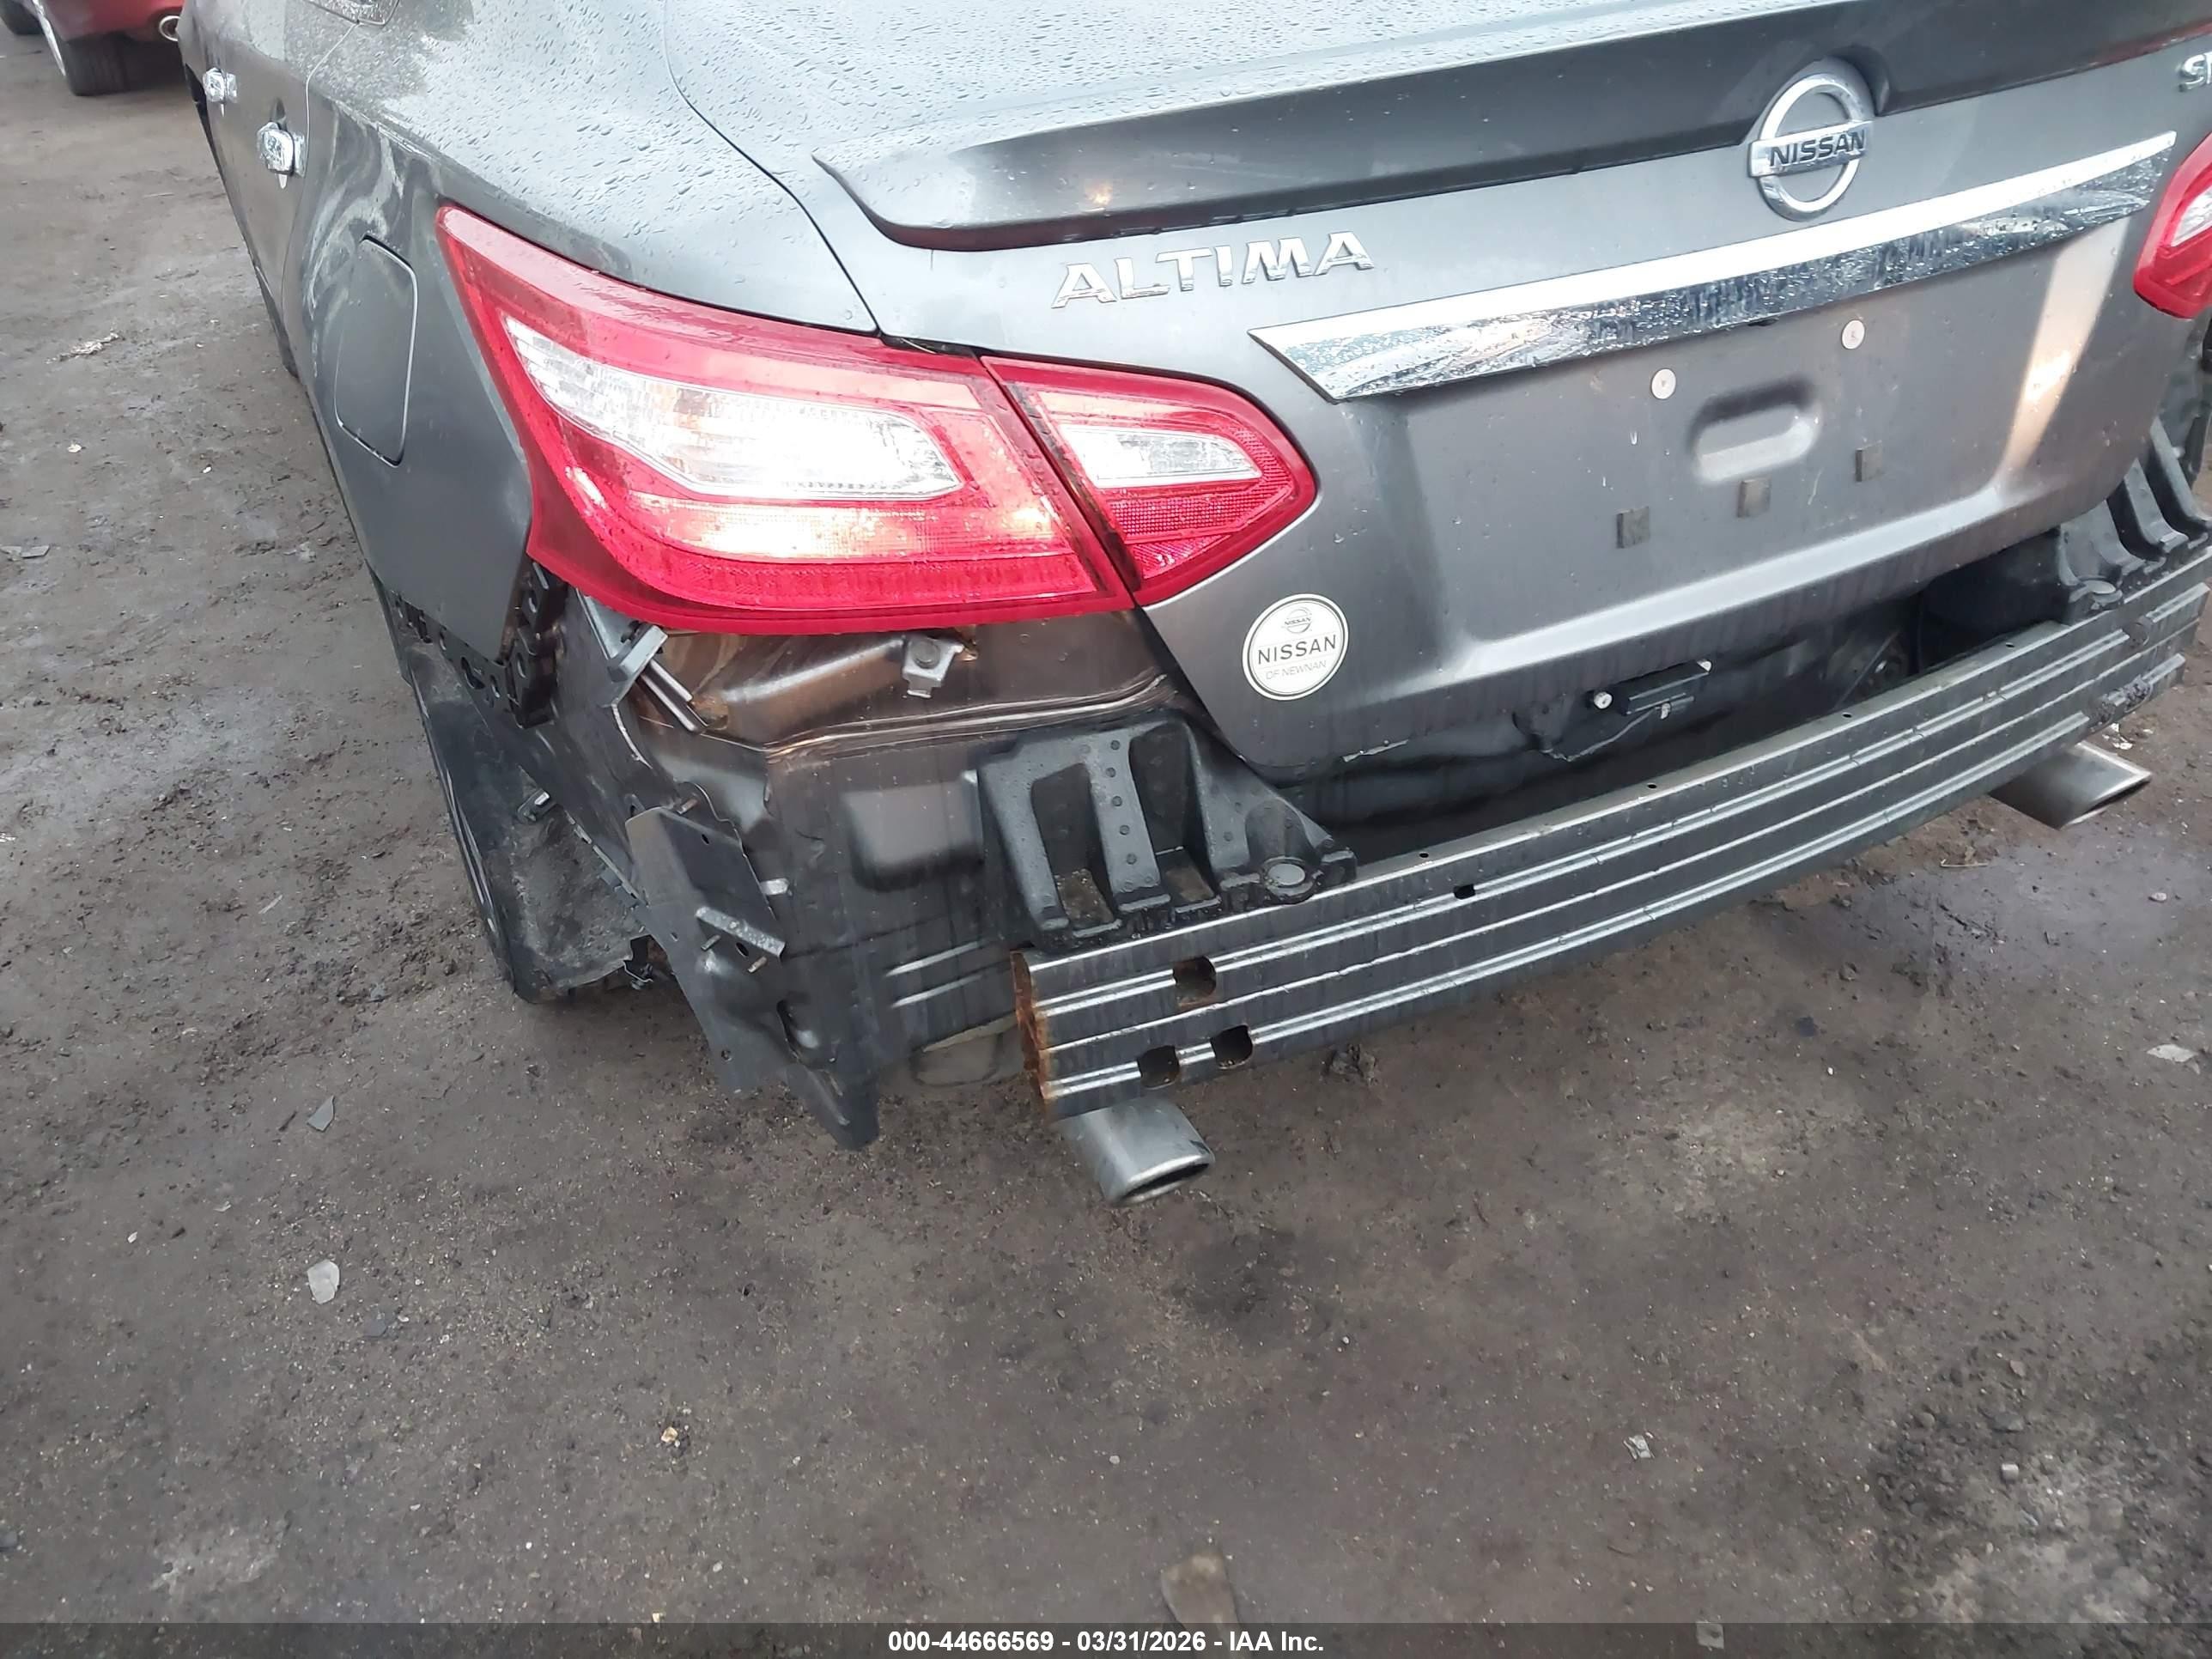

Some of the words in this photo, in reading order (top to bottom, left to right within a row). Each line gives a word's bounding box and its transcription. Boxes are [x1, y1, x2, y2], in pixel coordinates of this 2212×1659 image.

[1770, 129, 1865, 167] NISSAN
[1051, 231, 1374, 308] ALTIMA
[1258, 634, 1336, 665] NISSAN
[1266, 670, 1279, 680] OF
